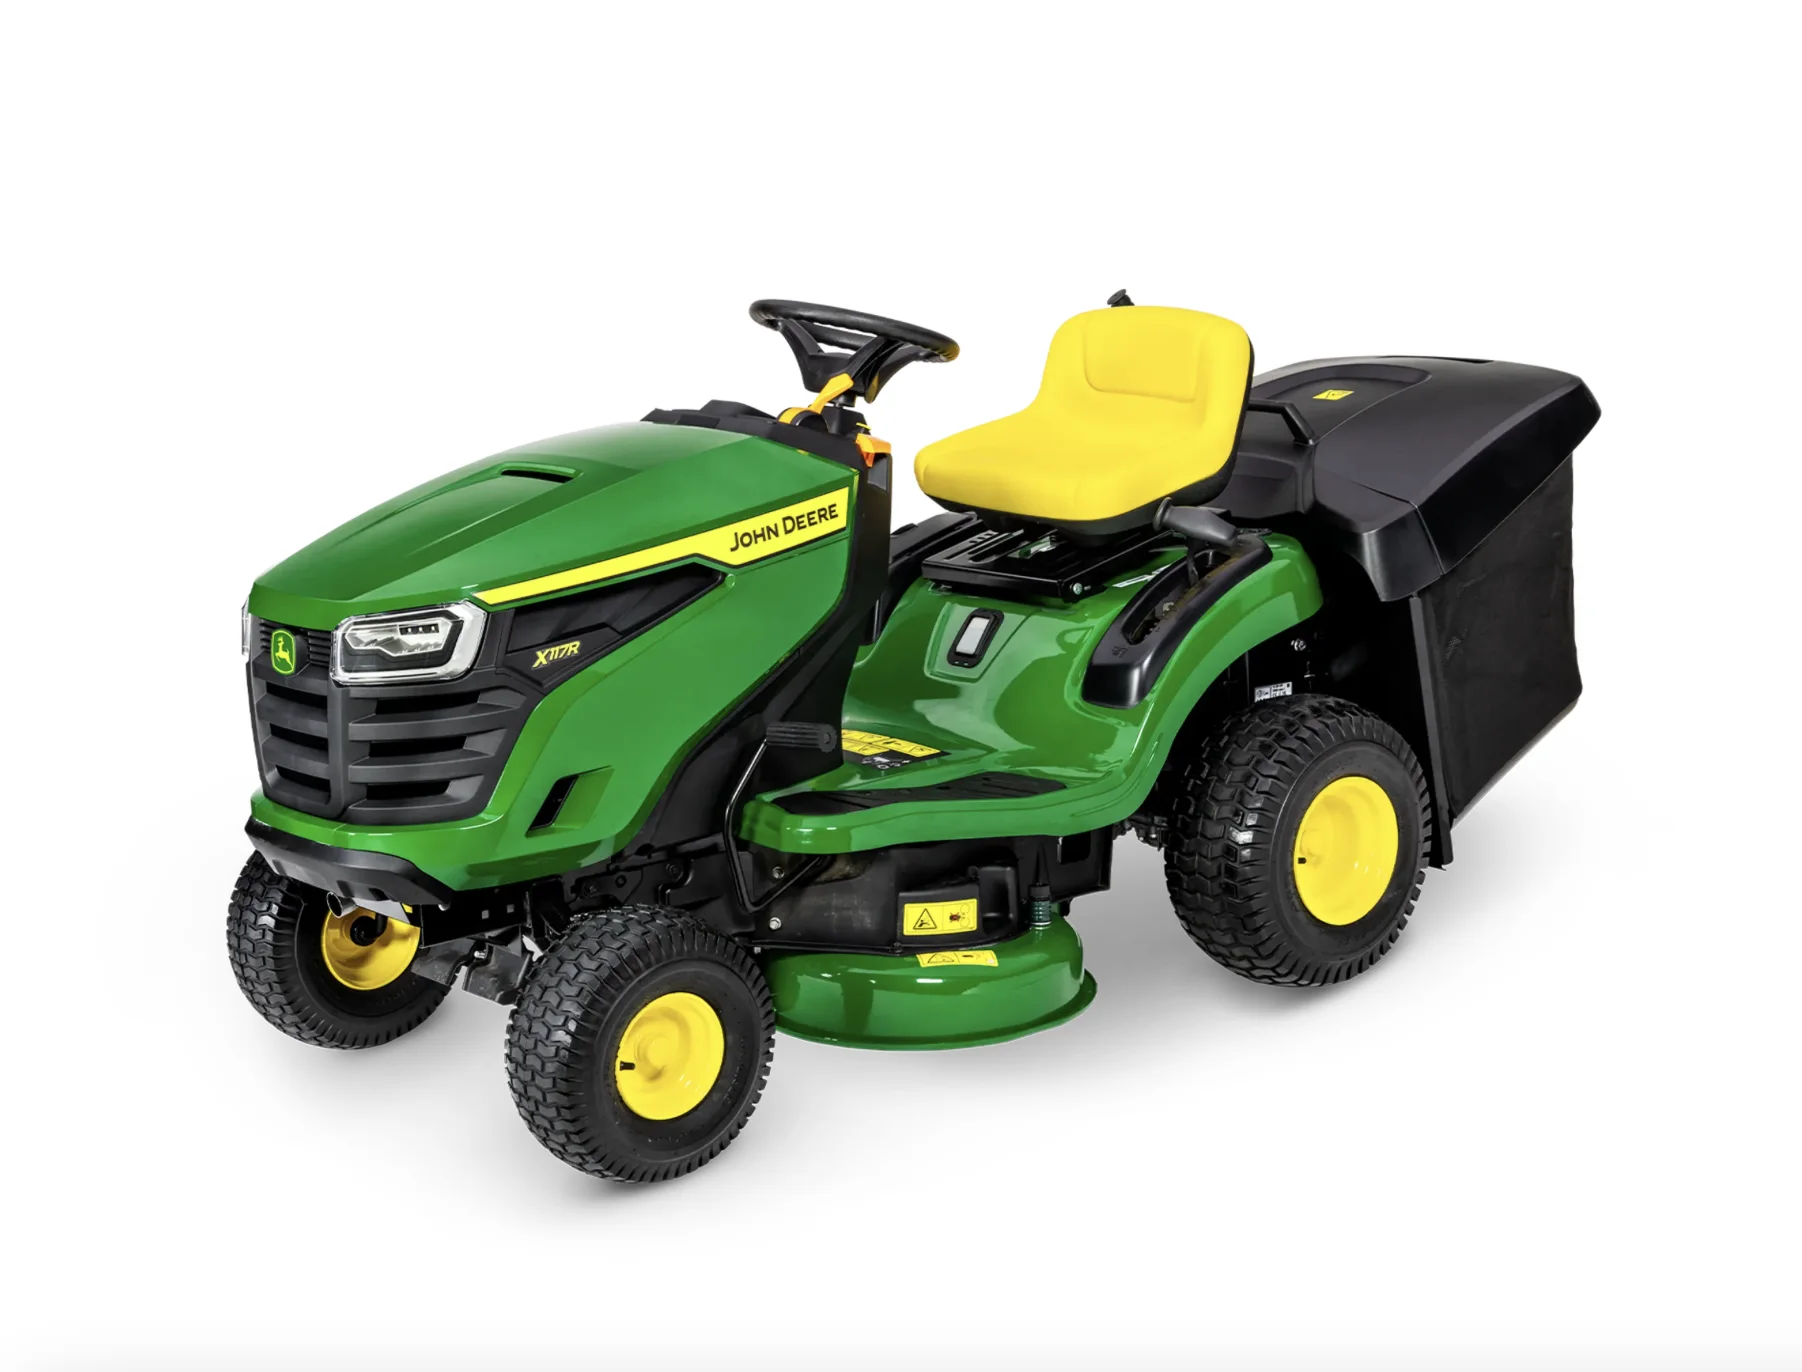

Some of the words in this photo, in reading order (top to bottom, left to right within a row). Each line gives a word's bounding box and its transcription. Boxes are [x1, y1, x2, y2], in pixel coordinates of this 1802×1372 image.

[730, 522, 779, 552] JOHN
[782, 503, 839, 535] DEERE
[532, 640, 581, 668] X117R
